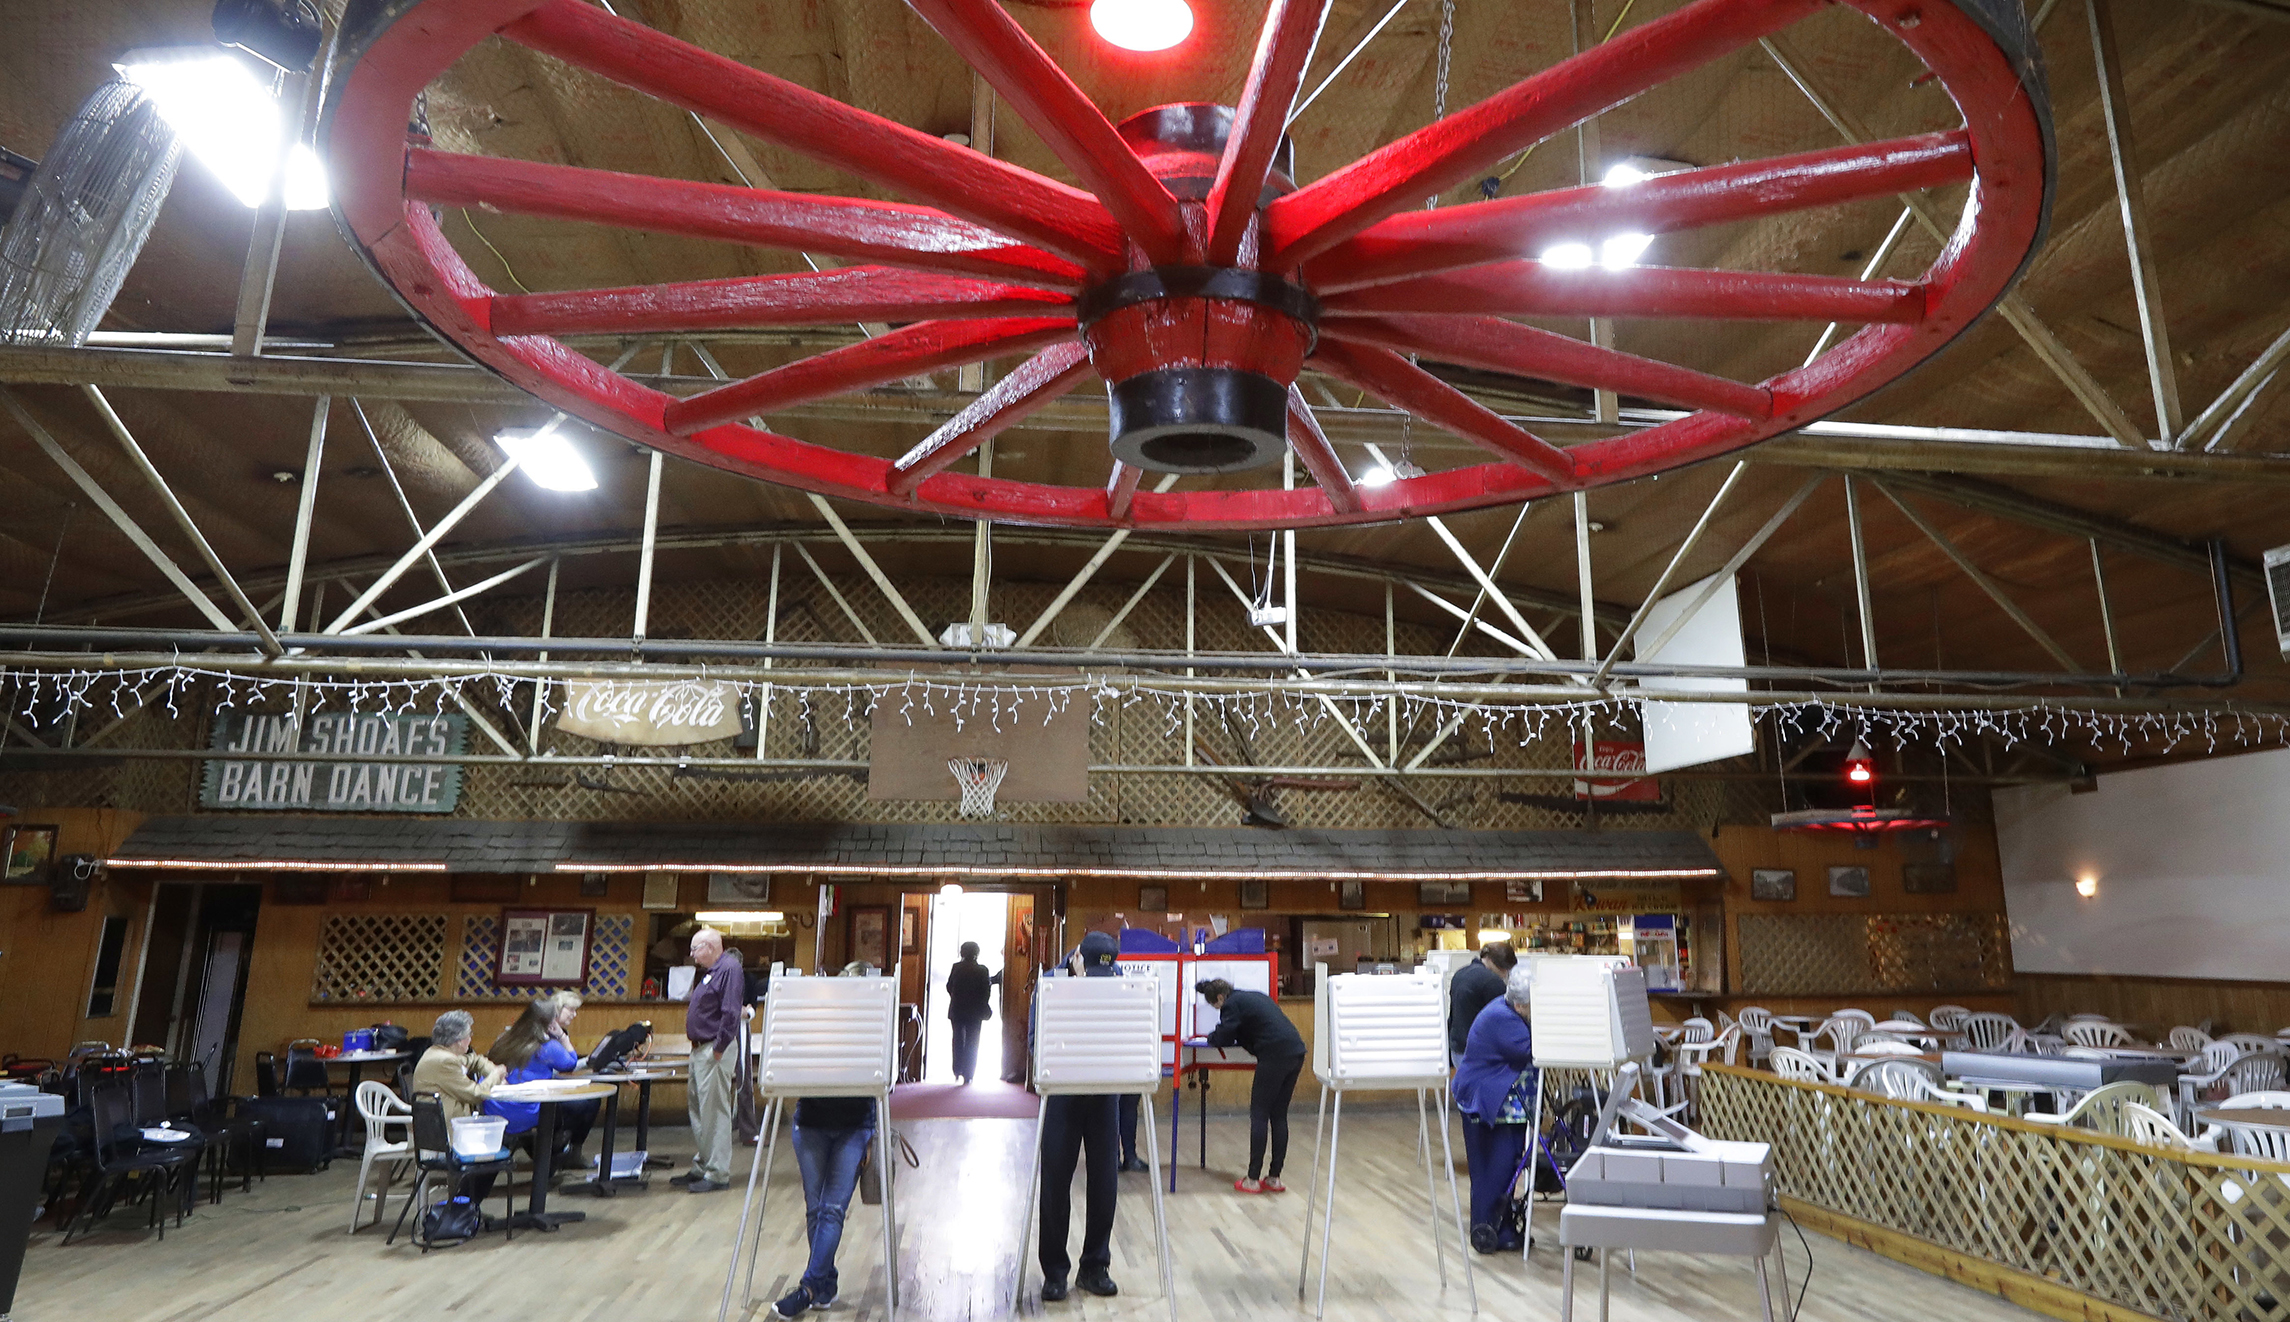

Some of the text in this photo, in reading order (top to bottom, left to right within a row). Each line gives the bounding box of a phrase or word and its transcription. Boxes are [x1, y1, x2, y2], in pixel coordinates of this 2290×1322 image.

[576, 681, 732, 729] Coca-Cola
[228, 714, 448, 756] JIM SHOAF'S
[1579, 749, 1646, 772] Cca-Cola
[218, 761, 442, 805] BARN DANCE
[1574, 895, 1627, 911] Rwan
